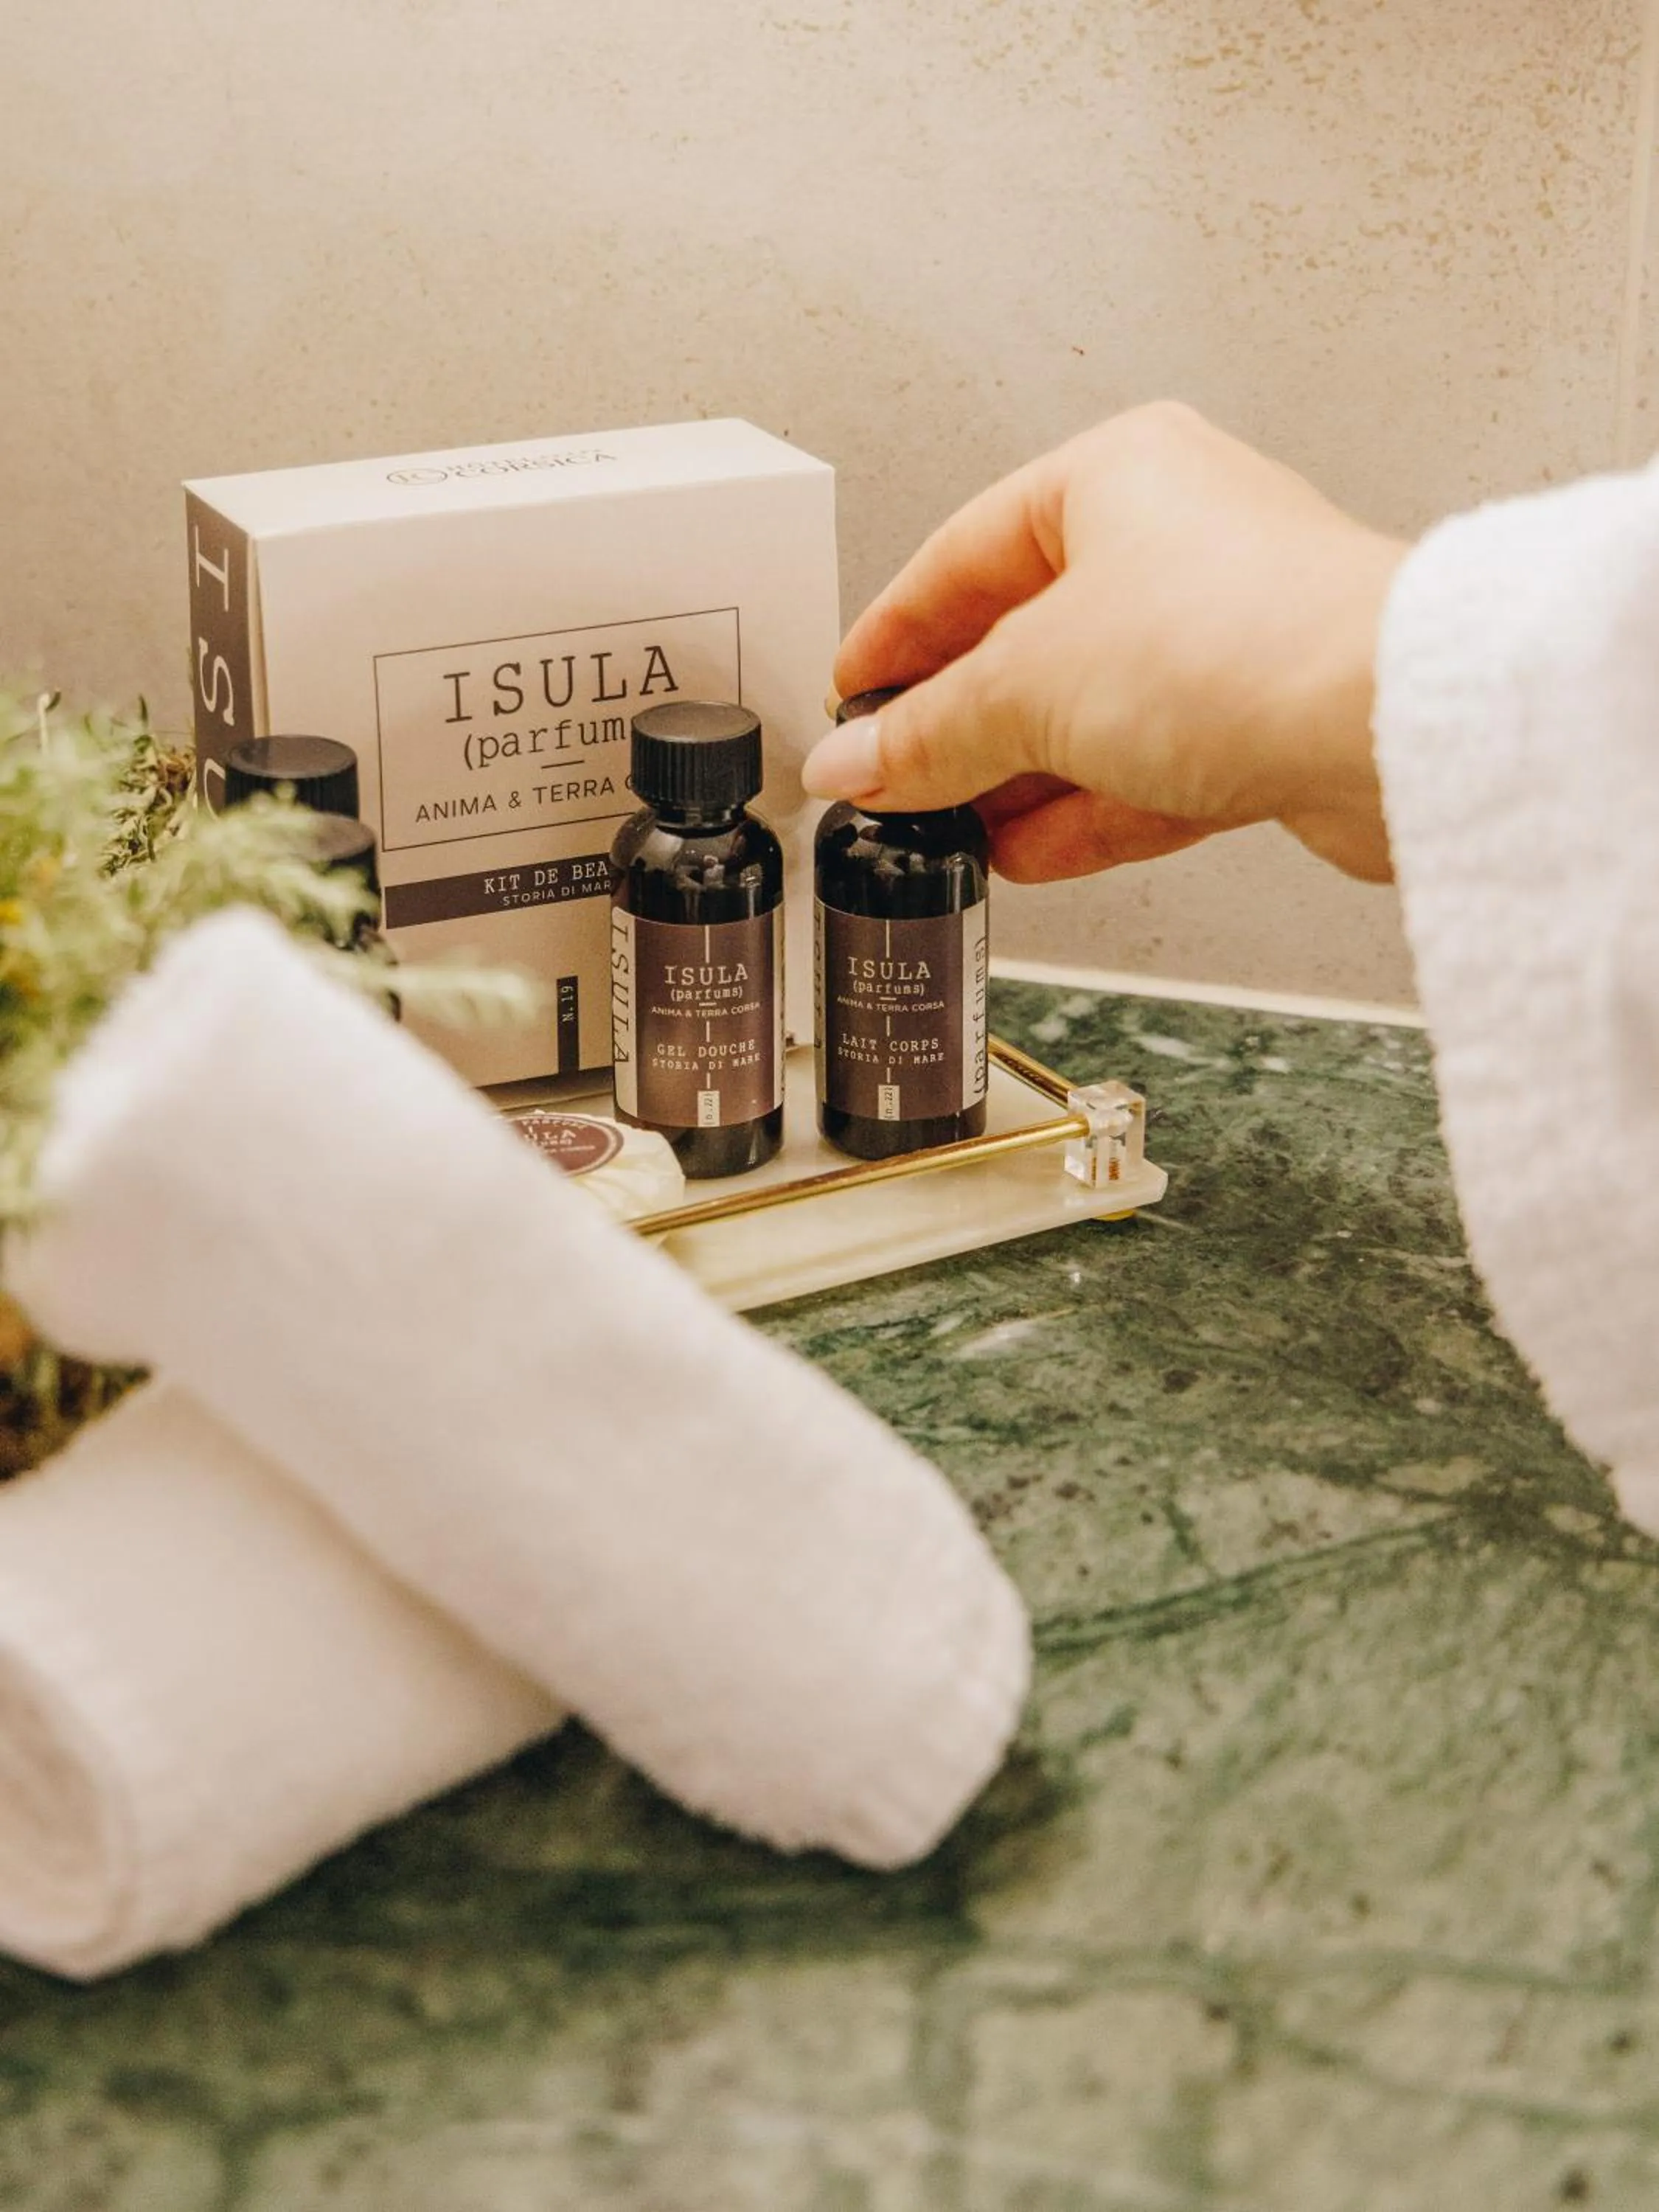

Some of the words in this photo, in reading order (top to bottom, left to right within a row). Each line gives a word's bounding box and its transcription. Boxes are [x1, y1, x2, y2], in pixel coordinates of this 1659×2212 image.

[443, 644, 679, 723] ISULA
[415, 793, 497, 823] ANIMA
[508, 790, 522, 809] &
[532, 776, 616, 804] TERRA
[483, 873, 521, 894] KIT
[534, 867, 558, 886] DE
[572, 860, 609, 880] BEA
[502, 889, 555, 906] STORIA
[561, 885, 575, 897] DI
[664, 962, 749, 986] ISULA
[848, 956, 932, 981] ISULA
[612, 925, 629, 1062] ISULA
[670, 985, 743, 1002] (parfums)
[852, 979, 925, 997] (parfums)
[651, 1005, 683, 1017] ANIMA
[695, 1008, 729, 1018] TERRA
[731, 1001, 761, 1015] CORSA
[836, 995, 864, 1009] ANIMA
[876, 1004, 909, 1013] TERRA
[911, 1000, 945, 1012] CORSA
[657, 1043, 686, 1057] GEL
[698, 1038, 756, 1059] DOUCHE
[842, 1033, 877, 1051] LAIT
[889, 1037, 939, 1053] CORPS
[652, 1058, 699, 1071] STORIA
[709, 1060, 723, 1070] DI
[732, 1052, 761, 1068] MARE
[838, 1046, 880, 1065] STORIA
[888, 1055, 902, 1065] DI
[914, 1052, 945, 1065] MARE
